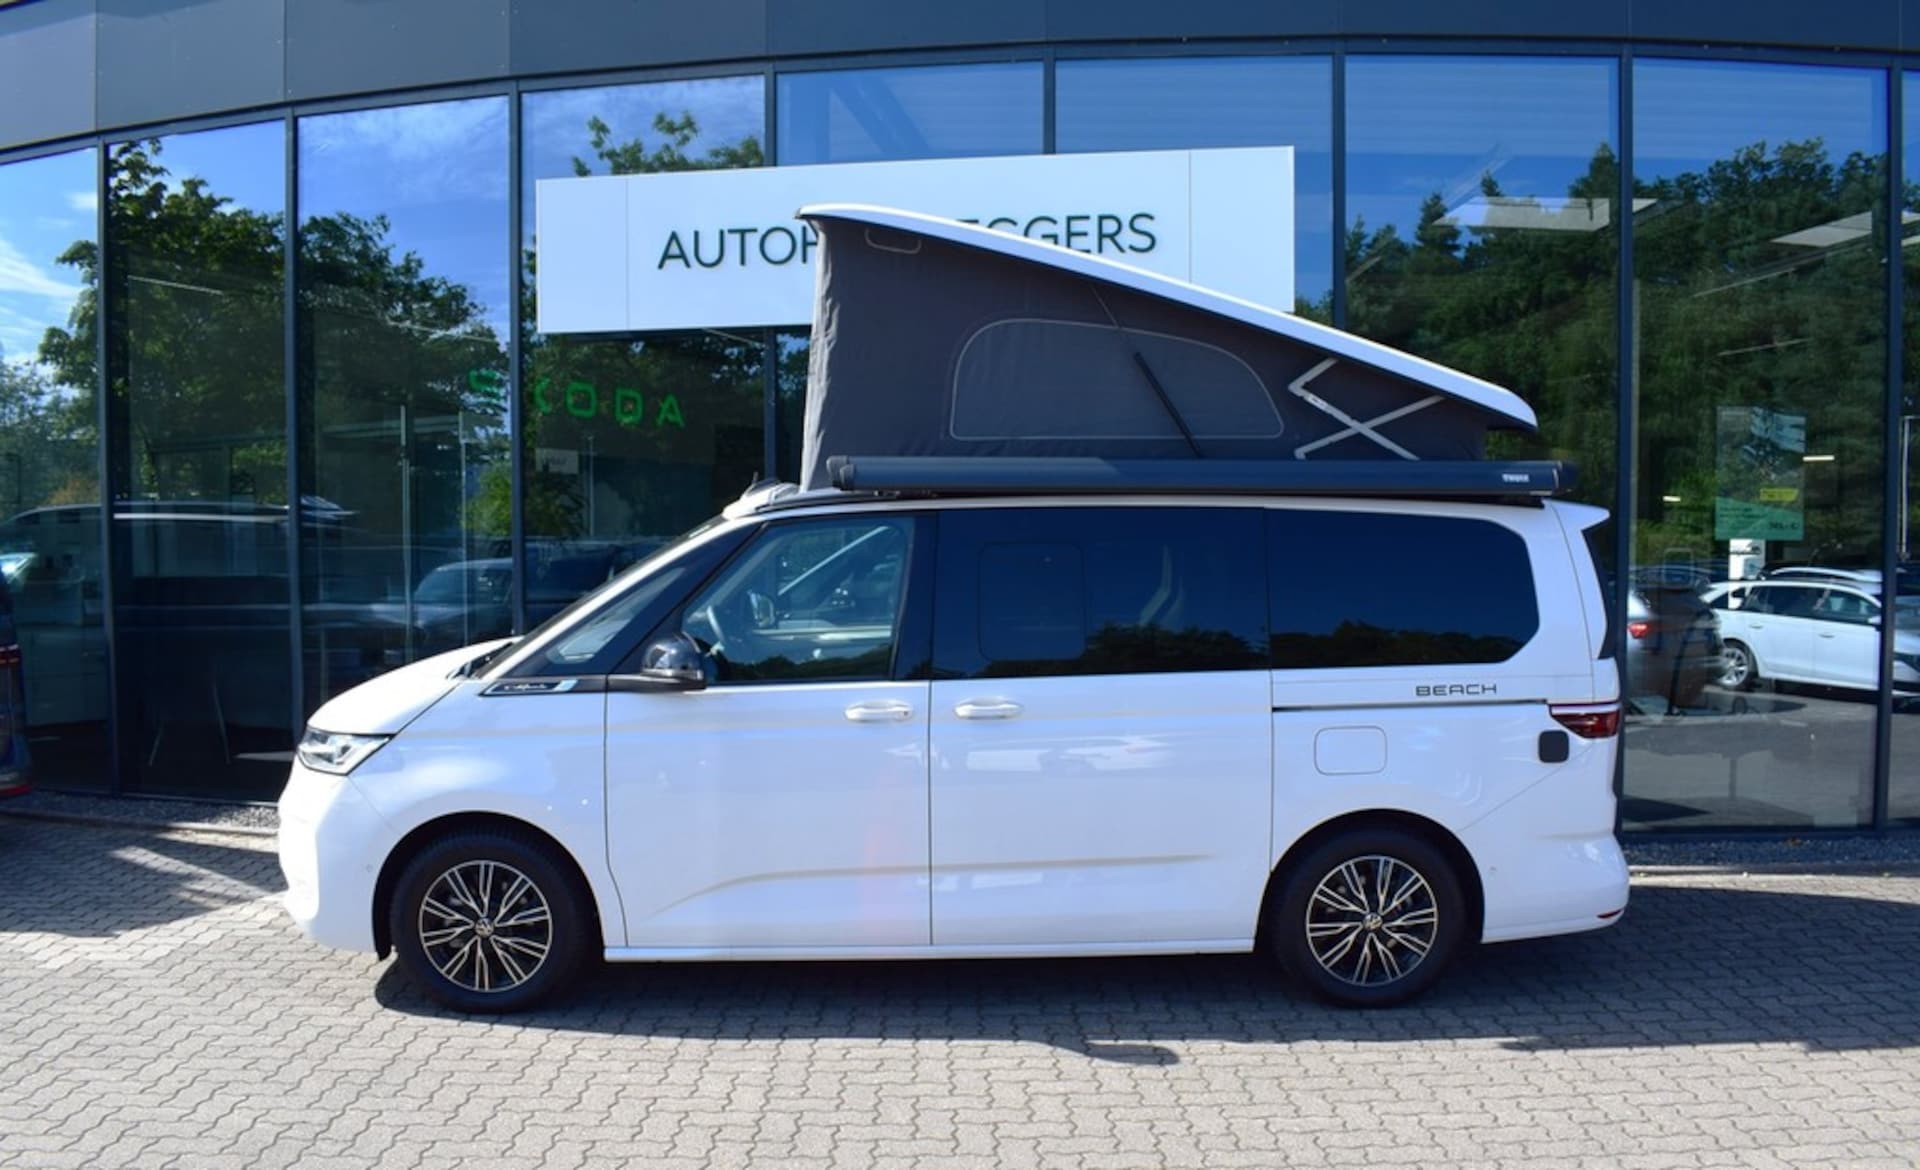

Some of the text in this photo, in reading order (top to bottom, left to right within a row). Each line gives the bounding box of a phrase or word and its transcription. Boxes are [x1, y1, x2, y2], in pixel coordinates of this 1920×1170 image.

[657, 212, 1157, 270] AUTOH GERS
[1415, 684, 1498, 697] BEACH
